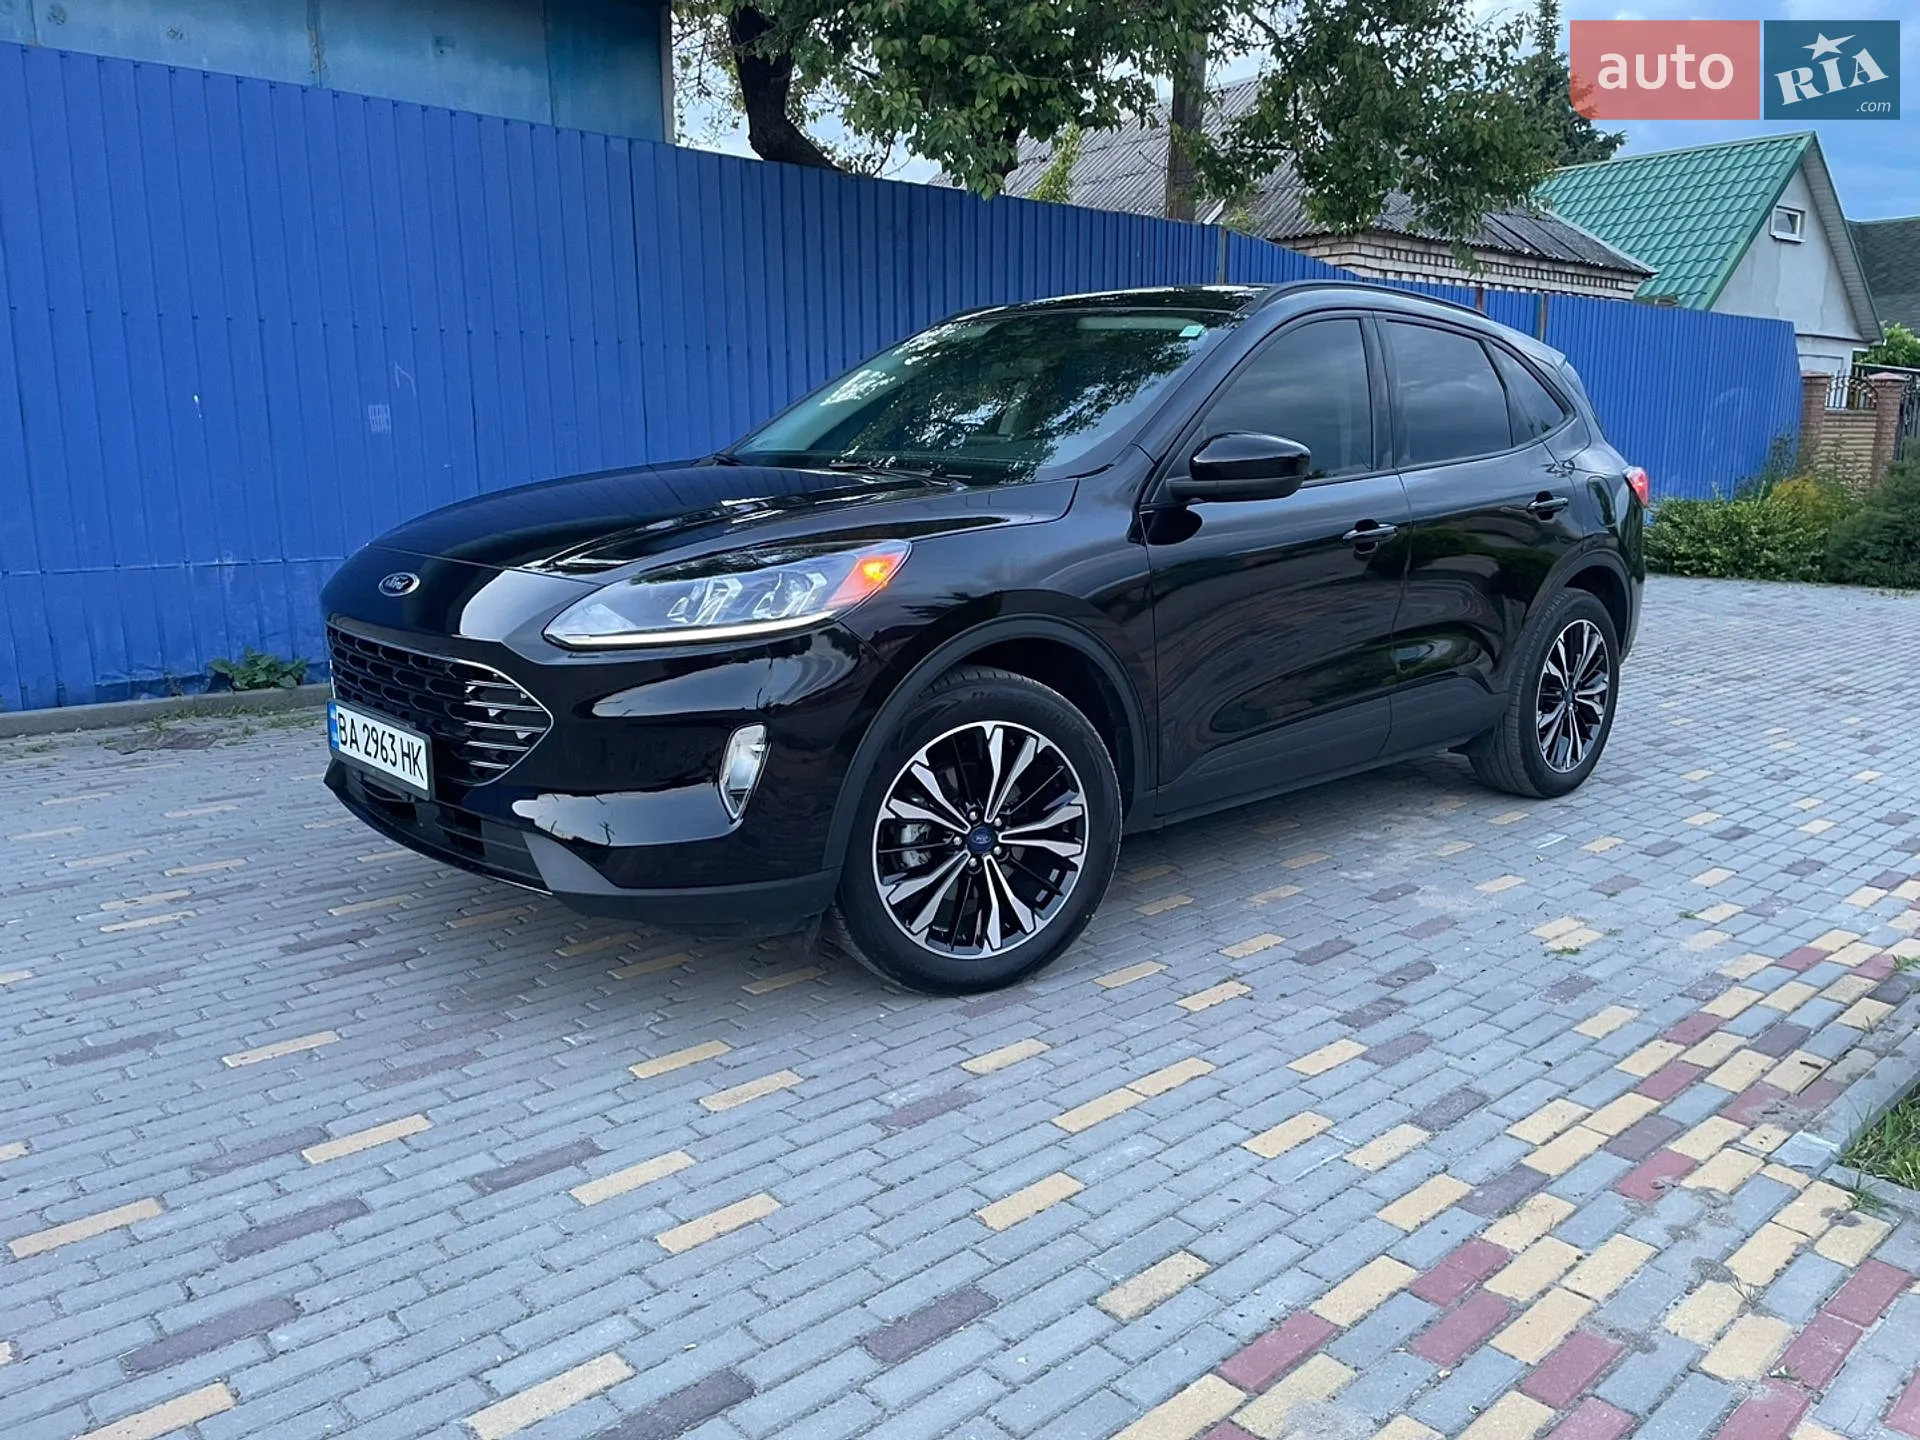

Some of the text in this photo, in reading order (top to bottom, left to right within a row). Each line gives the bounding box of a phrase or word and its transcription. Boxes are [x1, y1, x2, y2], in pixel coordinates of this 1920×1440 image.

[337, 712, 425, 781] BA 2963 HK
